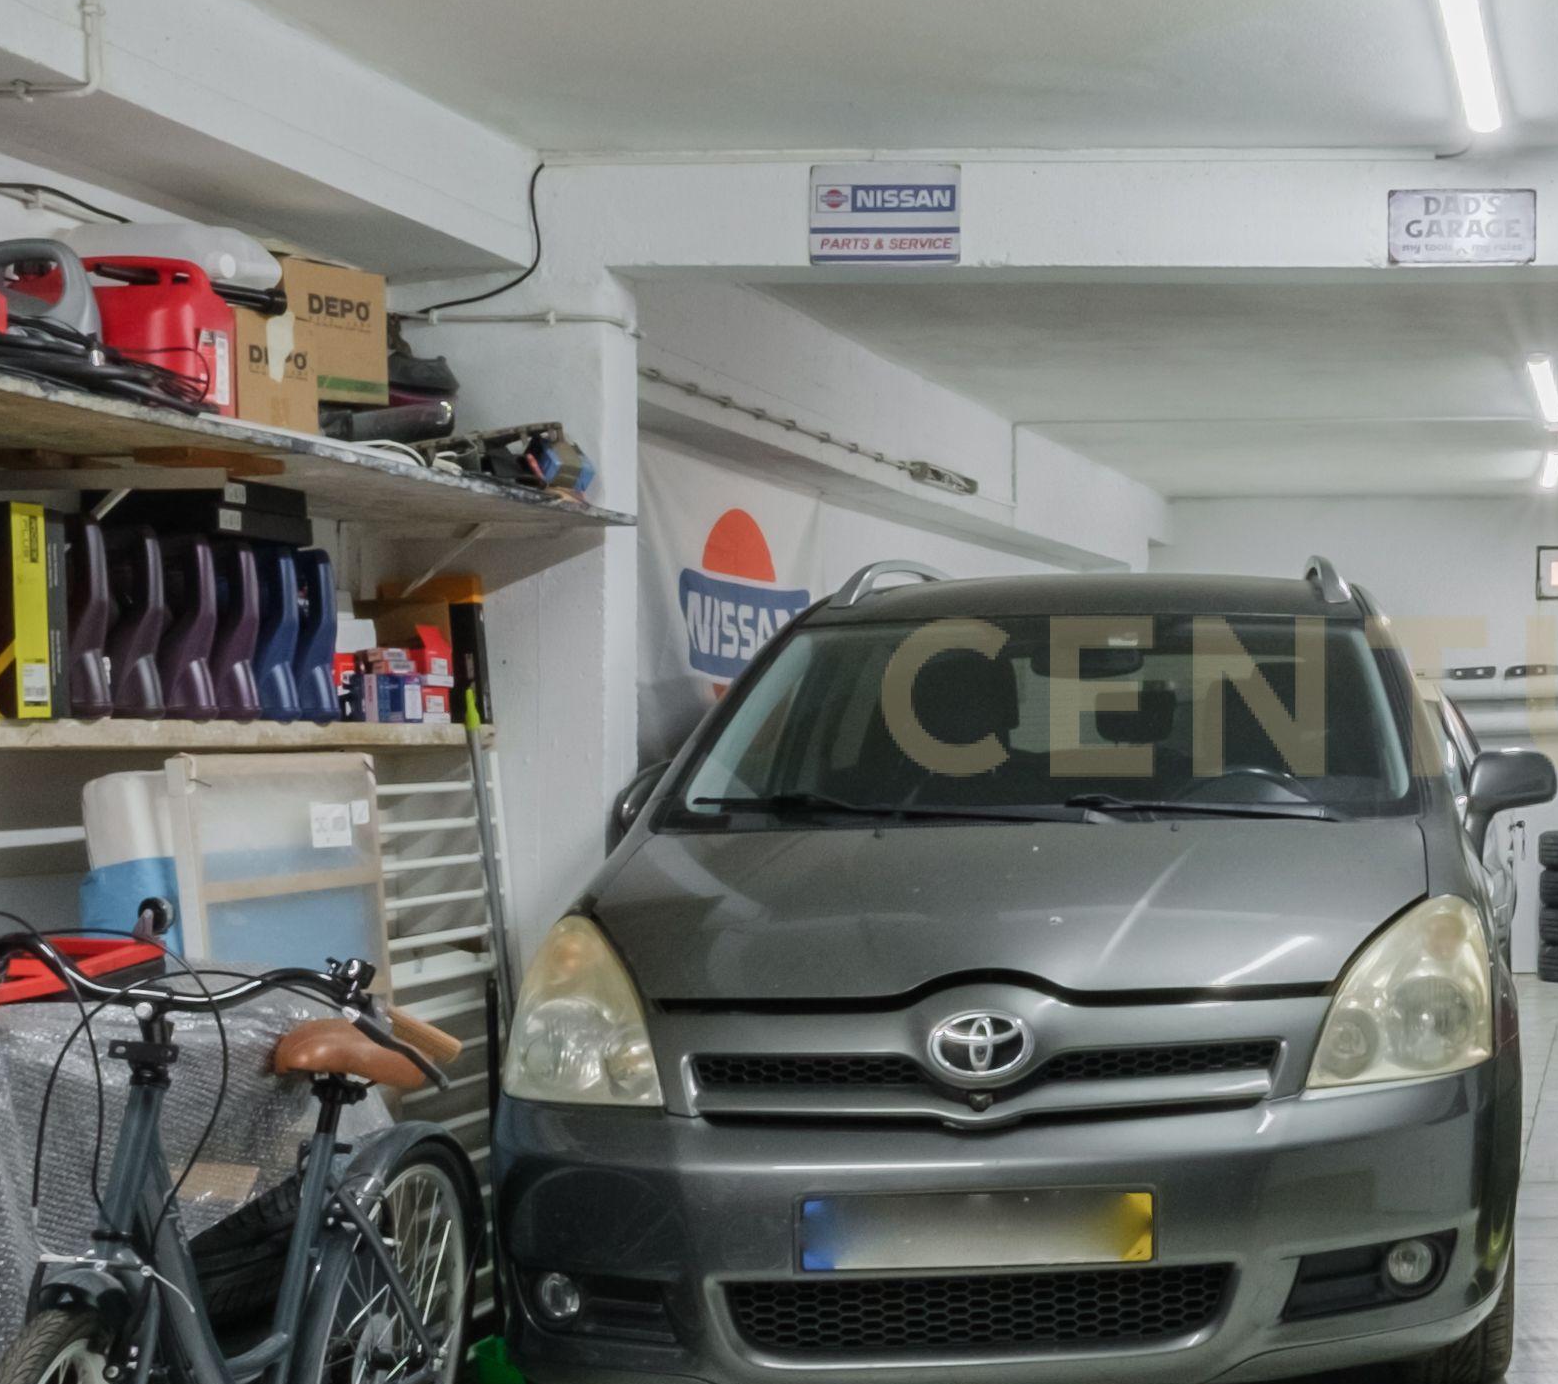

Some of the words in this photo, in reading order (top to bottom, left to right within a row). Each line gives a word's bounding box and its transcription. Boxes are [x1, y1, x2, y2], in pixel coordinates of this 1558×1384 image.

[856, 189, 951, 208] NISSAN
[1423, 195, 1501, 216] DAD'S
[1405, 219, 1521, 238] GARAGE
[820, 238, 869, 250] PARTS
[874, 237, 884, 250] &
[889, 237, 953, 250] SERVICE
[307, 293, 371, 322] DEPO
[248, 344, 308, 371] DO
[685, 590, 804, 661] NISSA
